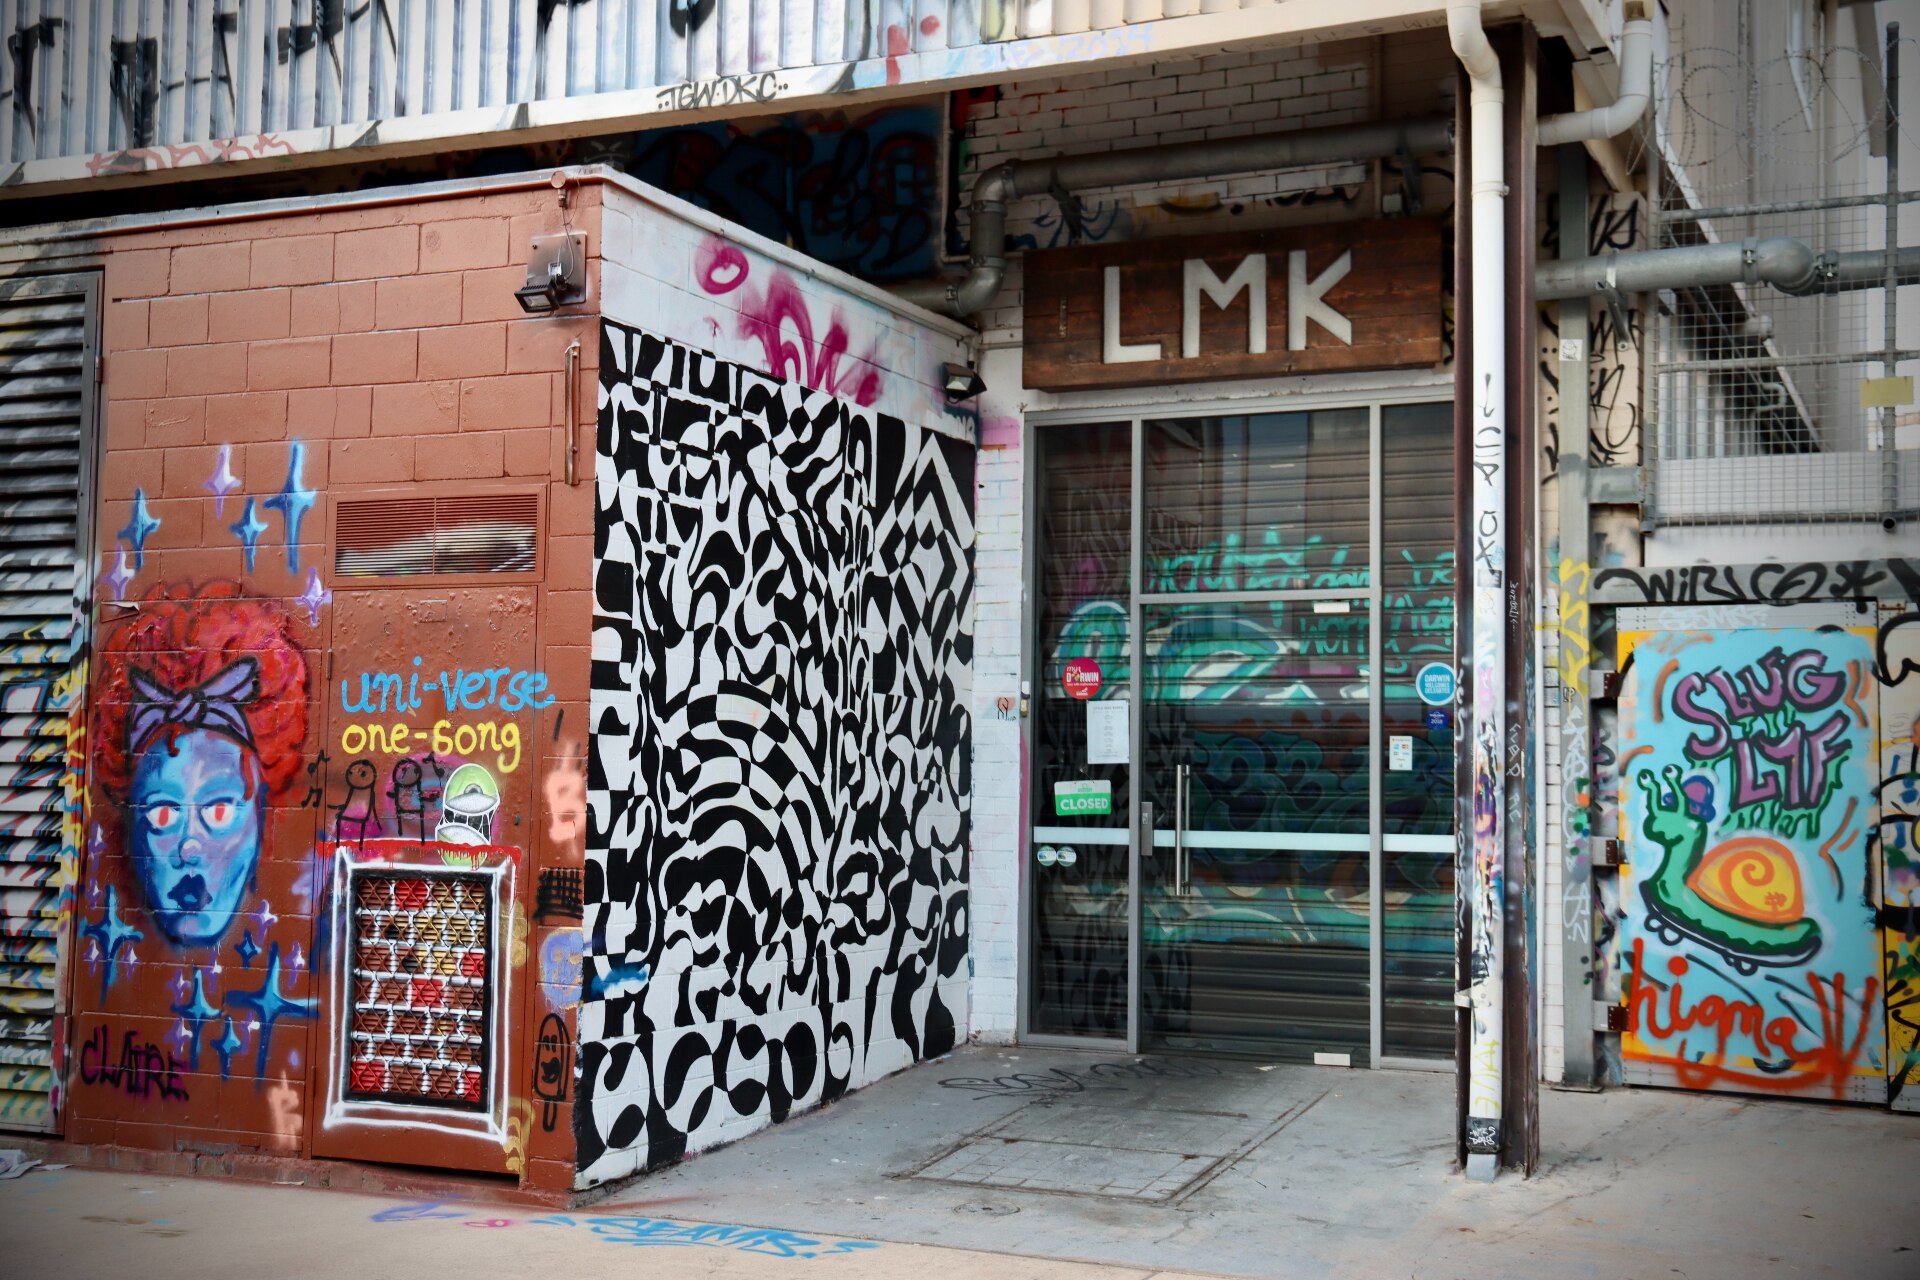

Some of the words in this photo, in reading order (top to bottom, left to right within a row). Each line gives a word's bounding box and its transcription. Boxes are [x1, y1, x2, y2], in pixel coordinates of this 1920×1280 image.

[1104, 249, 1352, 364] LMK
[341, 656, 556, 713] uni-verse
[1066, 672, 1099, 682] DRWIN
[1424, 674, 1450, 682] DARWIN
[1672, 646, 1846, 760] SLUG
[1060, 798, 1109, 810] CLOSED
